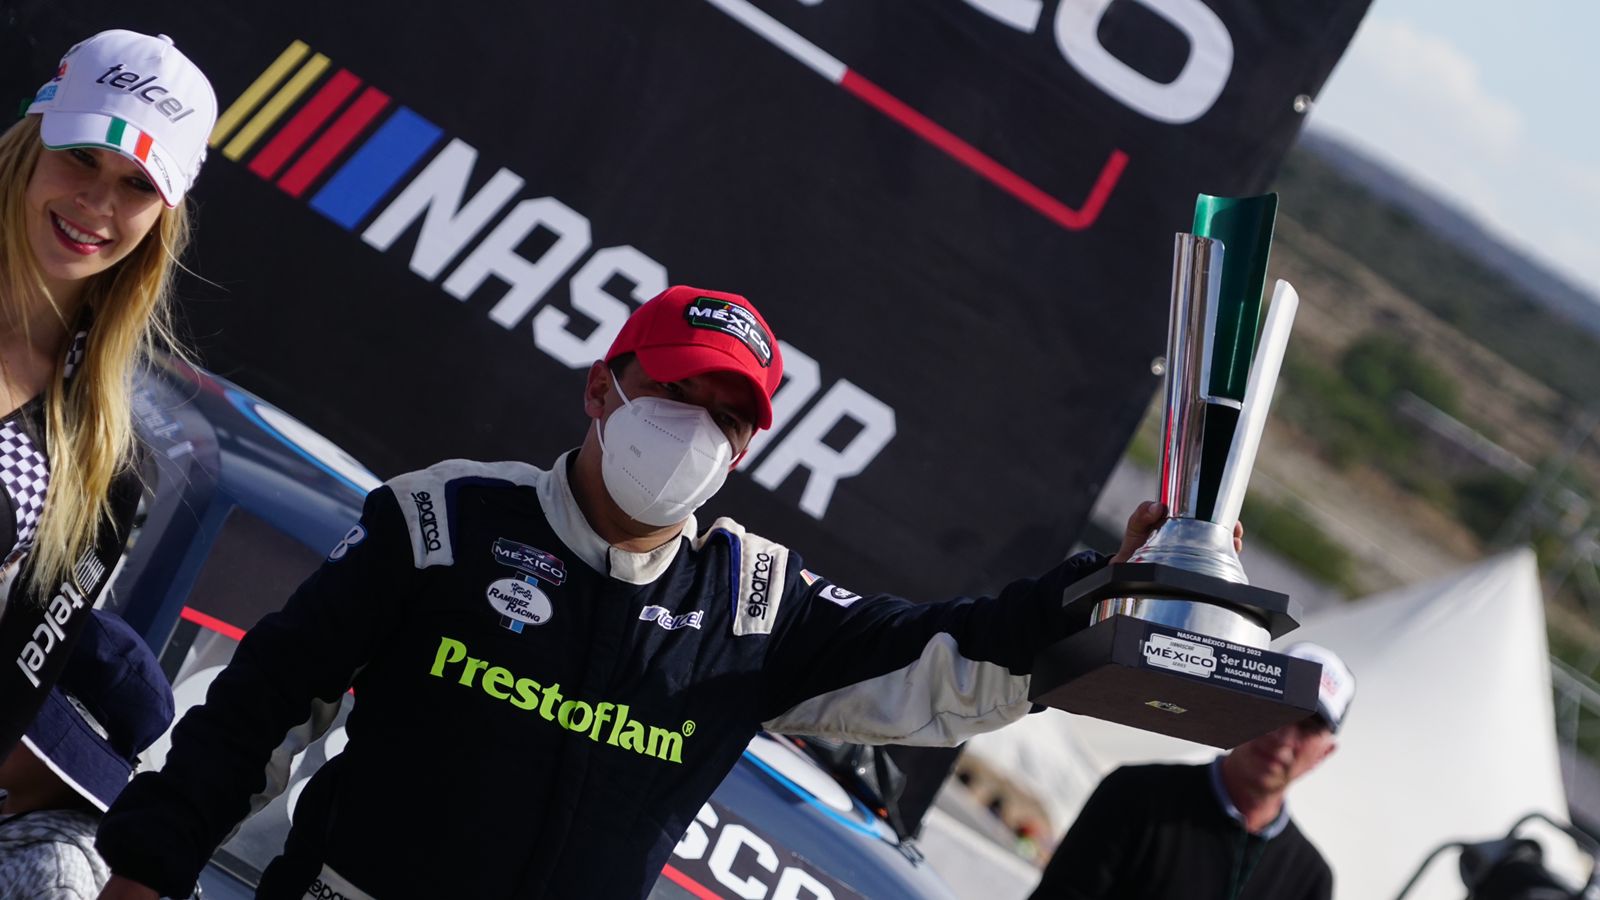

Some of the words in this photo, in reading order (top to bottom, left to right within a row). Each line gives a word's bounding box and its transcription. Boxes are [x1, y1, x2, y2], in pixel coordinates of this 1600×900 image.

[96, 64, 194, 123] telcel
[689, 306, 771, 360] MÉXICO
[412, 491, 442, 553] sparco
[488, 587, 530, 609] RAMIREZ
[748, 553, 774, 620] sparco
[505, 602, 542, 623] RACING
[16, 581, 85, 688] telcel
[1177, 631, 1202, 643] NASCAR
[1202, 637, 1226, 649] MÉXICO
[1246, 648, 1262, 657] 2022
[1145, 645, 1214, 669] MÉXICO
[1220, 654, 1241, 667] 3er
[1242, 659, 1282, 678] LUGAR
[1224, 667, 1251, 679] NASCAR
[1251, 673, 1277, 686] MÉXICO
